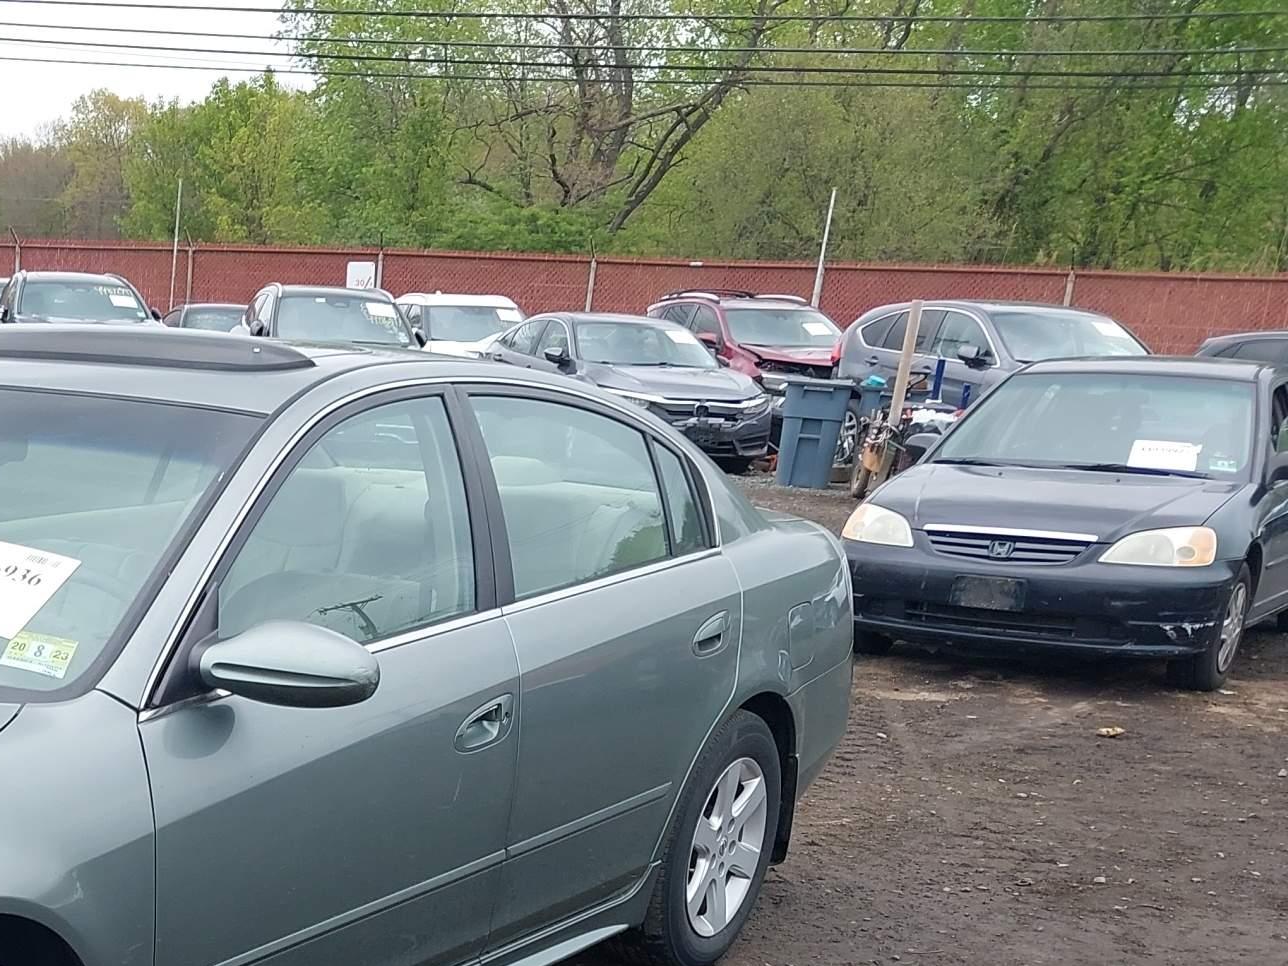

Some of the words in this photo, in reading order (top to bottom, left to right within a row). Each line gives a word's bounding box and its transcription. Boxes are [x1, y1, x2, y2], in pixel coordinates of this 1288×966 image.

[11, 641, 26, 651] 20
[33, 644, 45, 657] 8
[52, 649, 69, 661] 23
